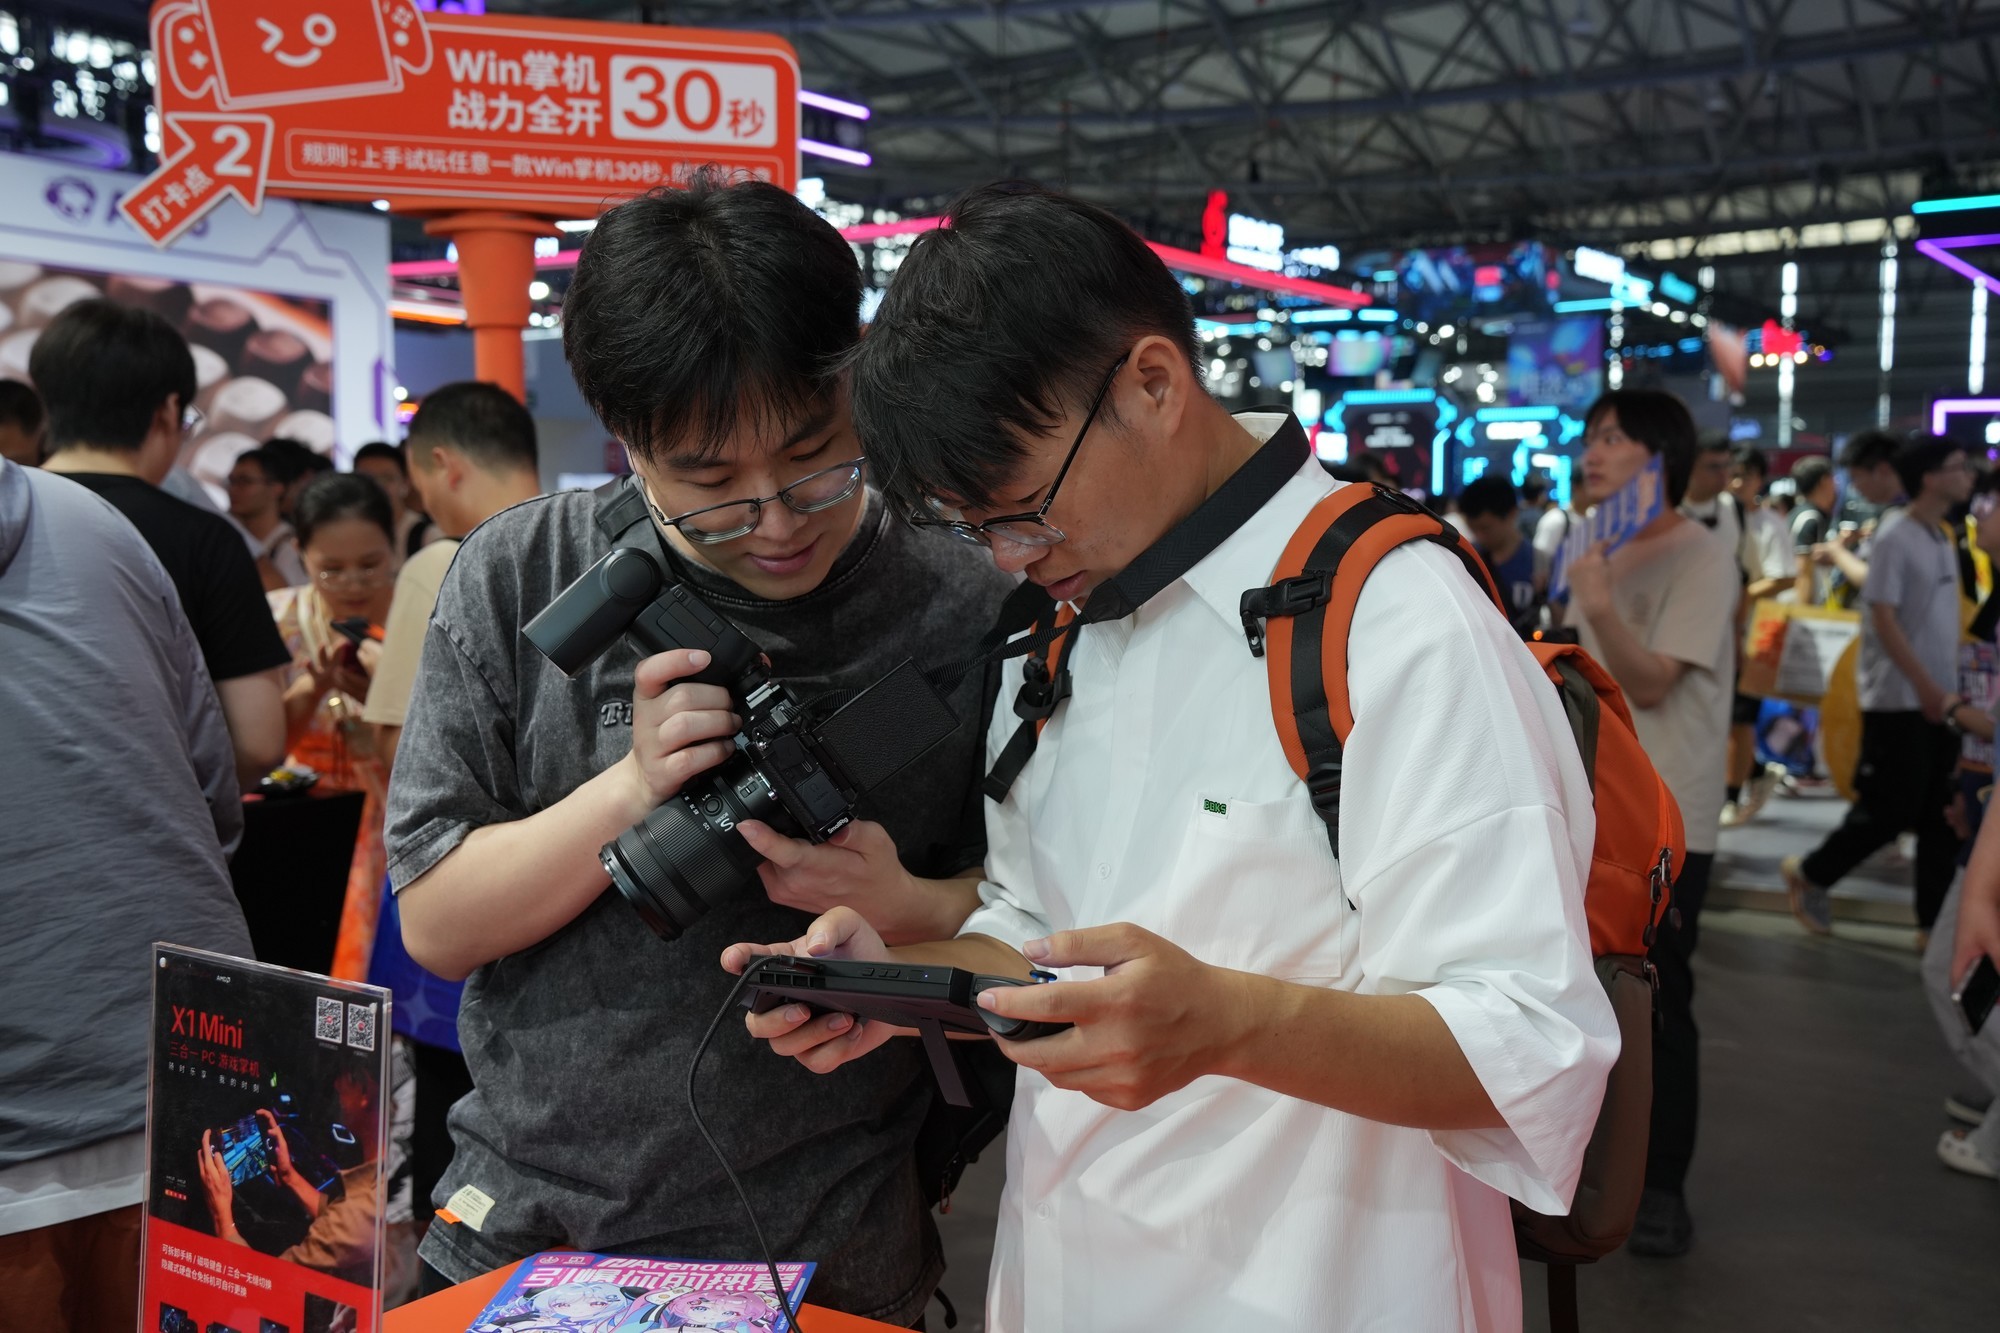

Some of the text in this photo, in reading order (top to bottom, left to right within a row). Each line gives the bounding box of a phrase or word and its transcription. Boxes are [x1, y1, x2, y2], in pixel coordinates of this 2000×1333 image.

[446, 49, 601, 94] Win掌机
[448, 89, 602, 137] 战力全开
[622, 65, 766, 139] 30秒
[212, 124, 253, 177] 2
[138, 163, 215, 230] 打卡点
[720, 818, 735, 832] S
[827, 816, 849, 834] SmallRig
[171, 1004, 242, 1049] X1 Mini
[169, 1041, 260, 1078] 三合一 PC 游戏掌机
[162, 1243, 193, 1263] 可拆卸手柄
